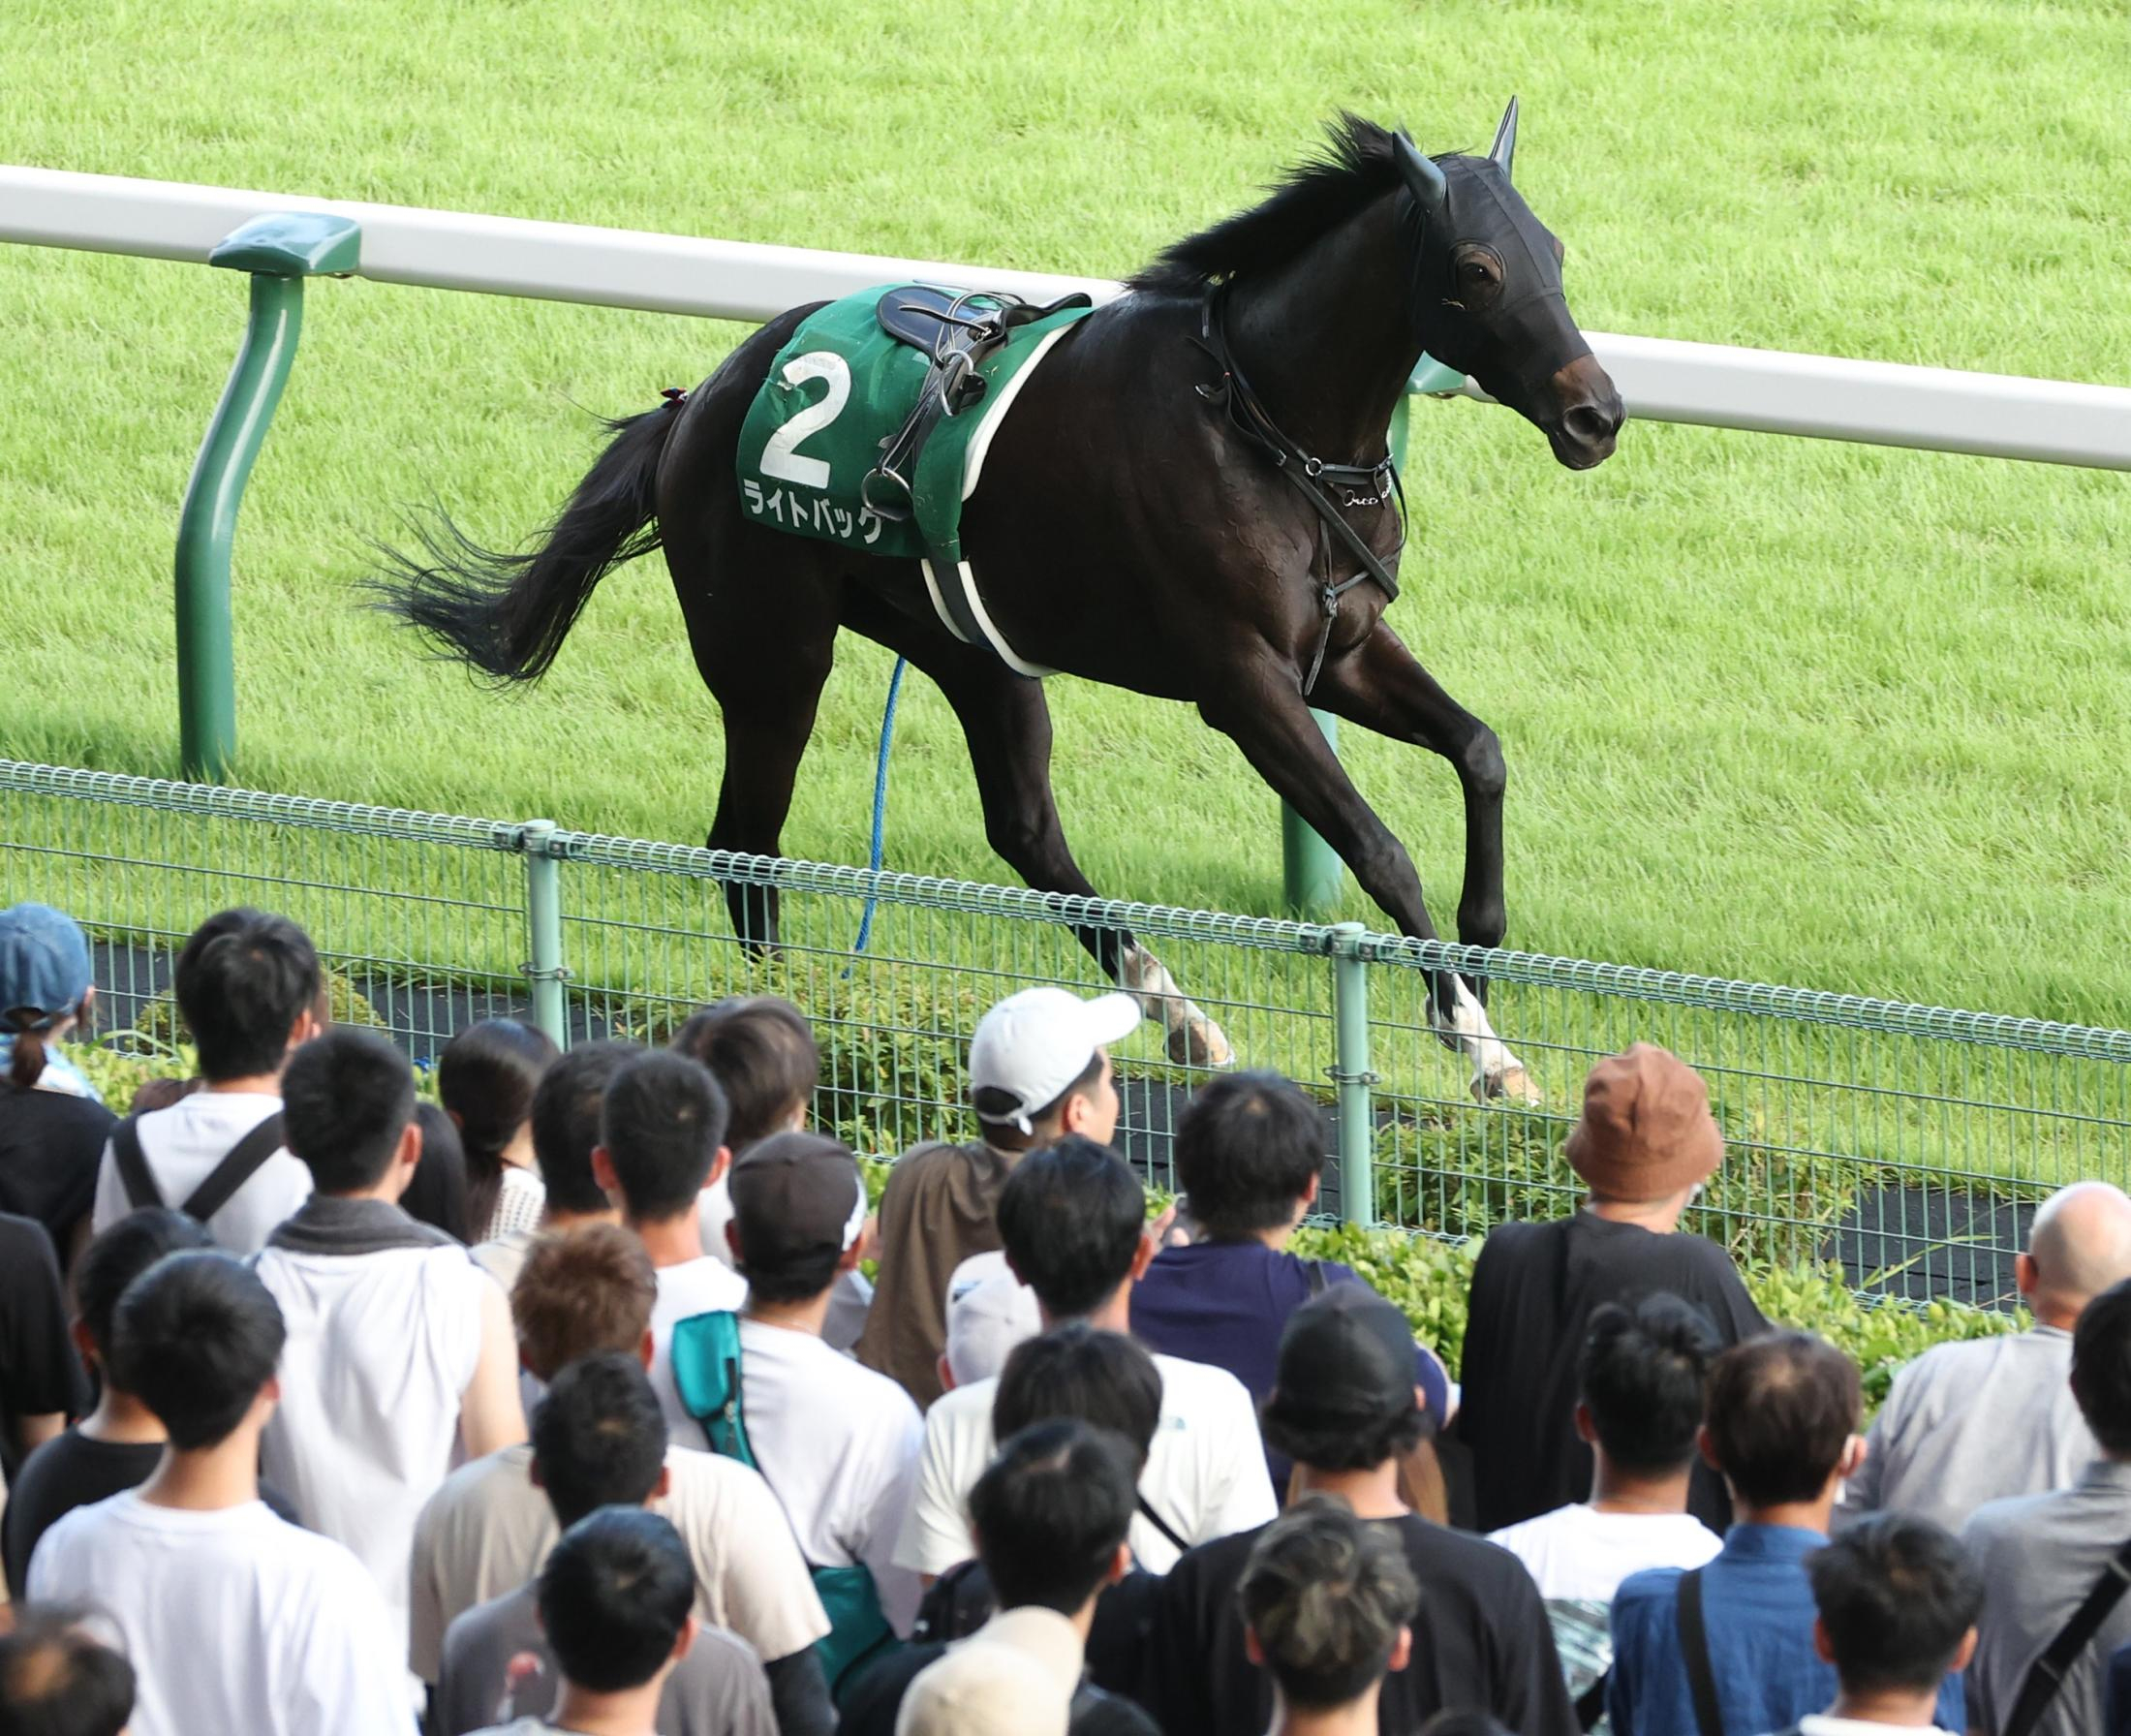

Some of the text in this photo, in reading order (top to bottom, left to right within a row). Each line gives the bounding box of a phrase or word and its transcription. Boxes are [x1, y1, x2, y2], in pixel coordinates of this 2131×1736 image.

[759, 351, 851, 489] 2
[744, 479, 882, 544] ライトバック
